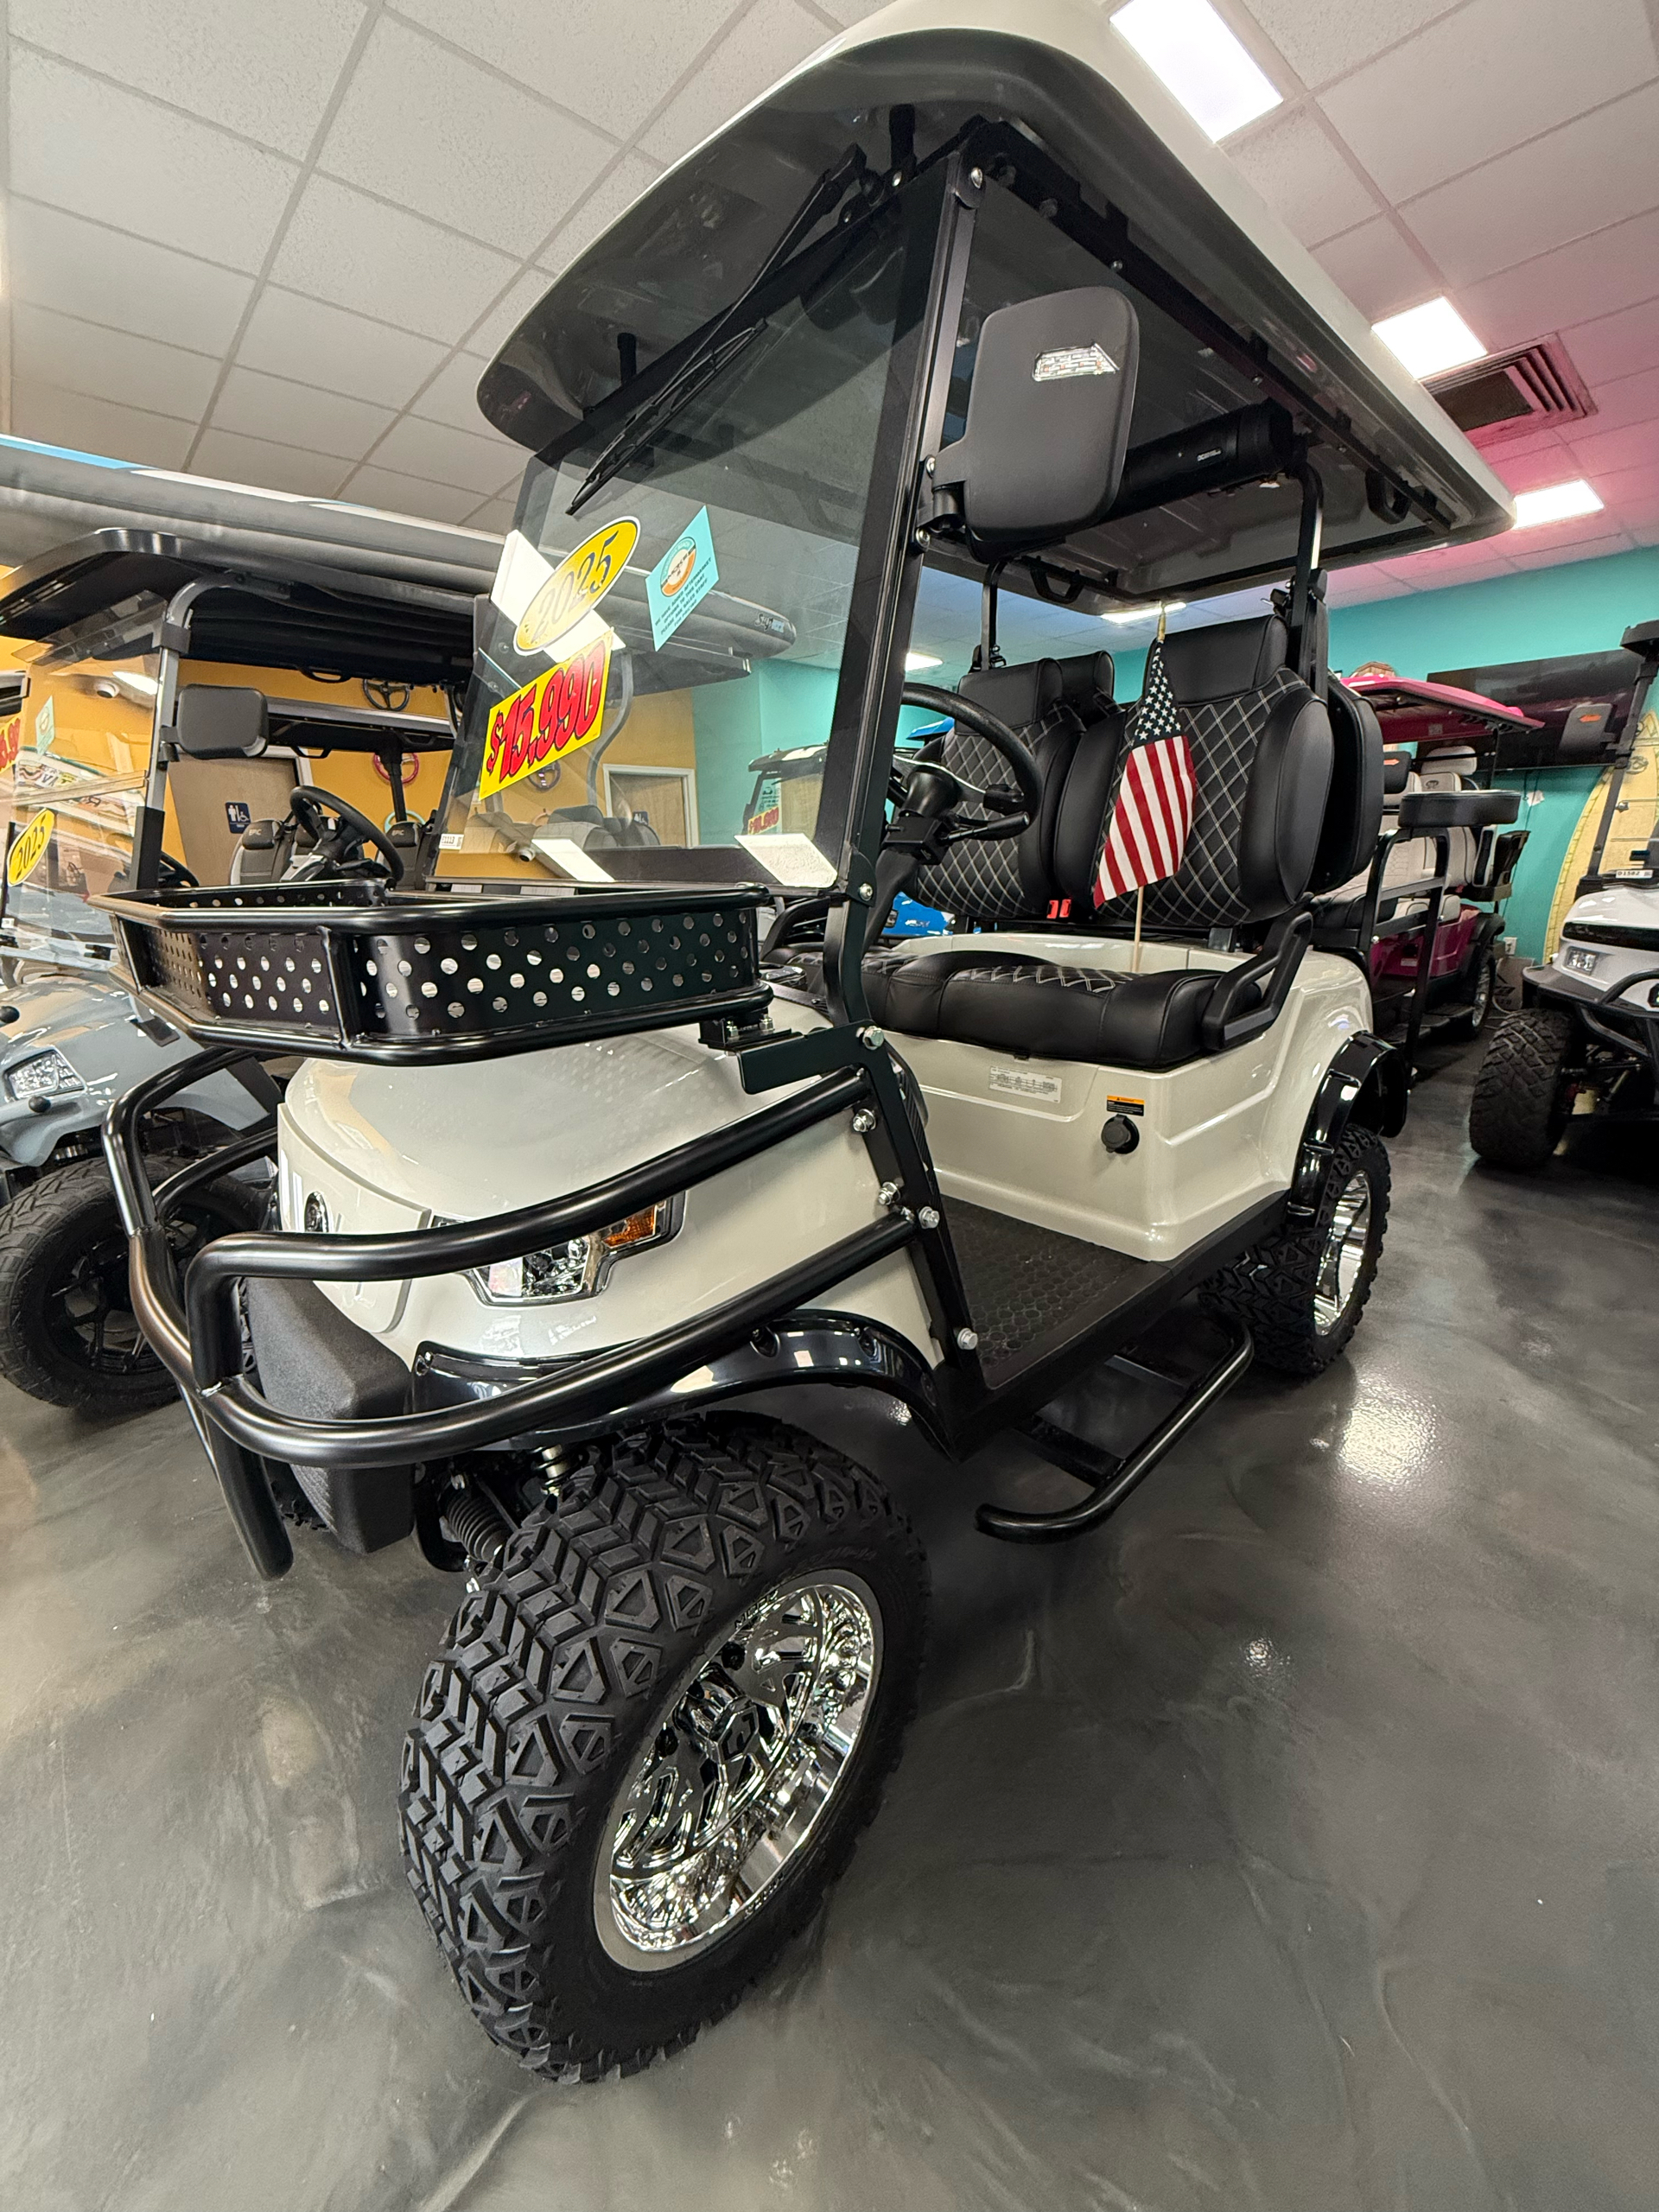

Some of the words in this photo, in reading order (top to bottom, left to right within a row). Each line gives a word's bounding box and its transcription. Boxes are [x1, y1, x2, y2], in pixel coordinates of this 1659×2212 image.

[531, 530, 620, 644] 2025
[655, 617, 660, 626] WE
[661, 605, 671, 620] HAVE
[671, 589, 683, 607] ADDED
[683, 556, 711, 593] AFTERMARKET
[661, 616, 674, 635] PLEASE
[683, 592, 695, 609] SALES
[696, 577, 707, 594] STAFF
[664, 602, 679, 624] OPTIONS
[695, 572, 704, 587] CART
[682, 598, 696, 617] PRICING
[486, 639, 606, 784] $15,990
[16, 814, 46, 880] 2025
